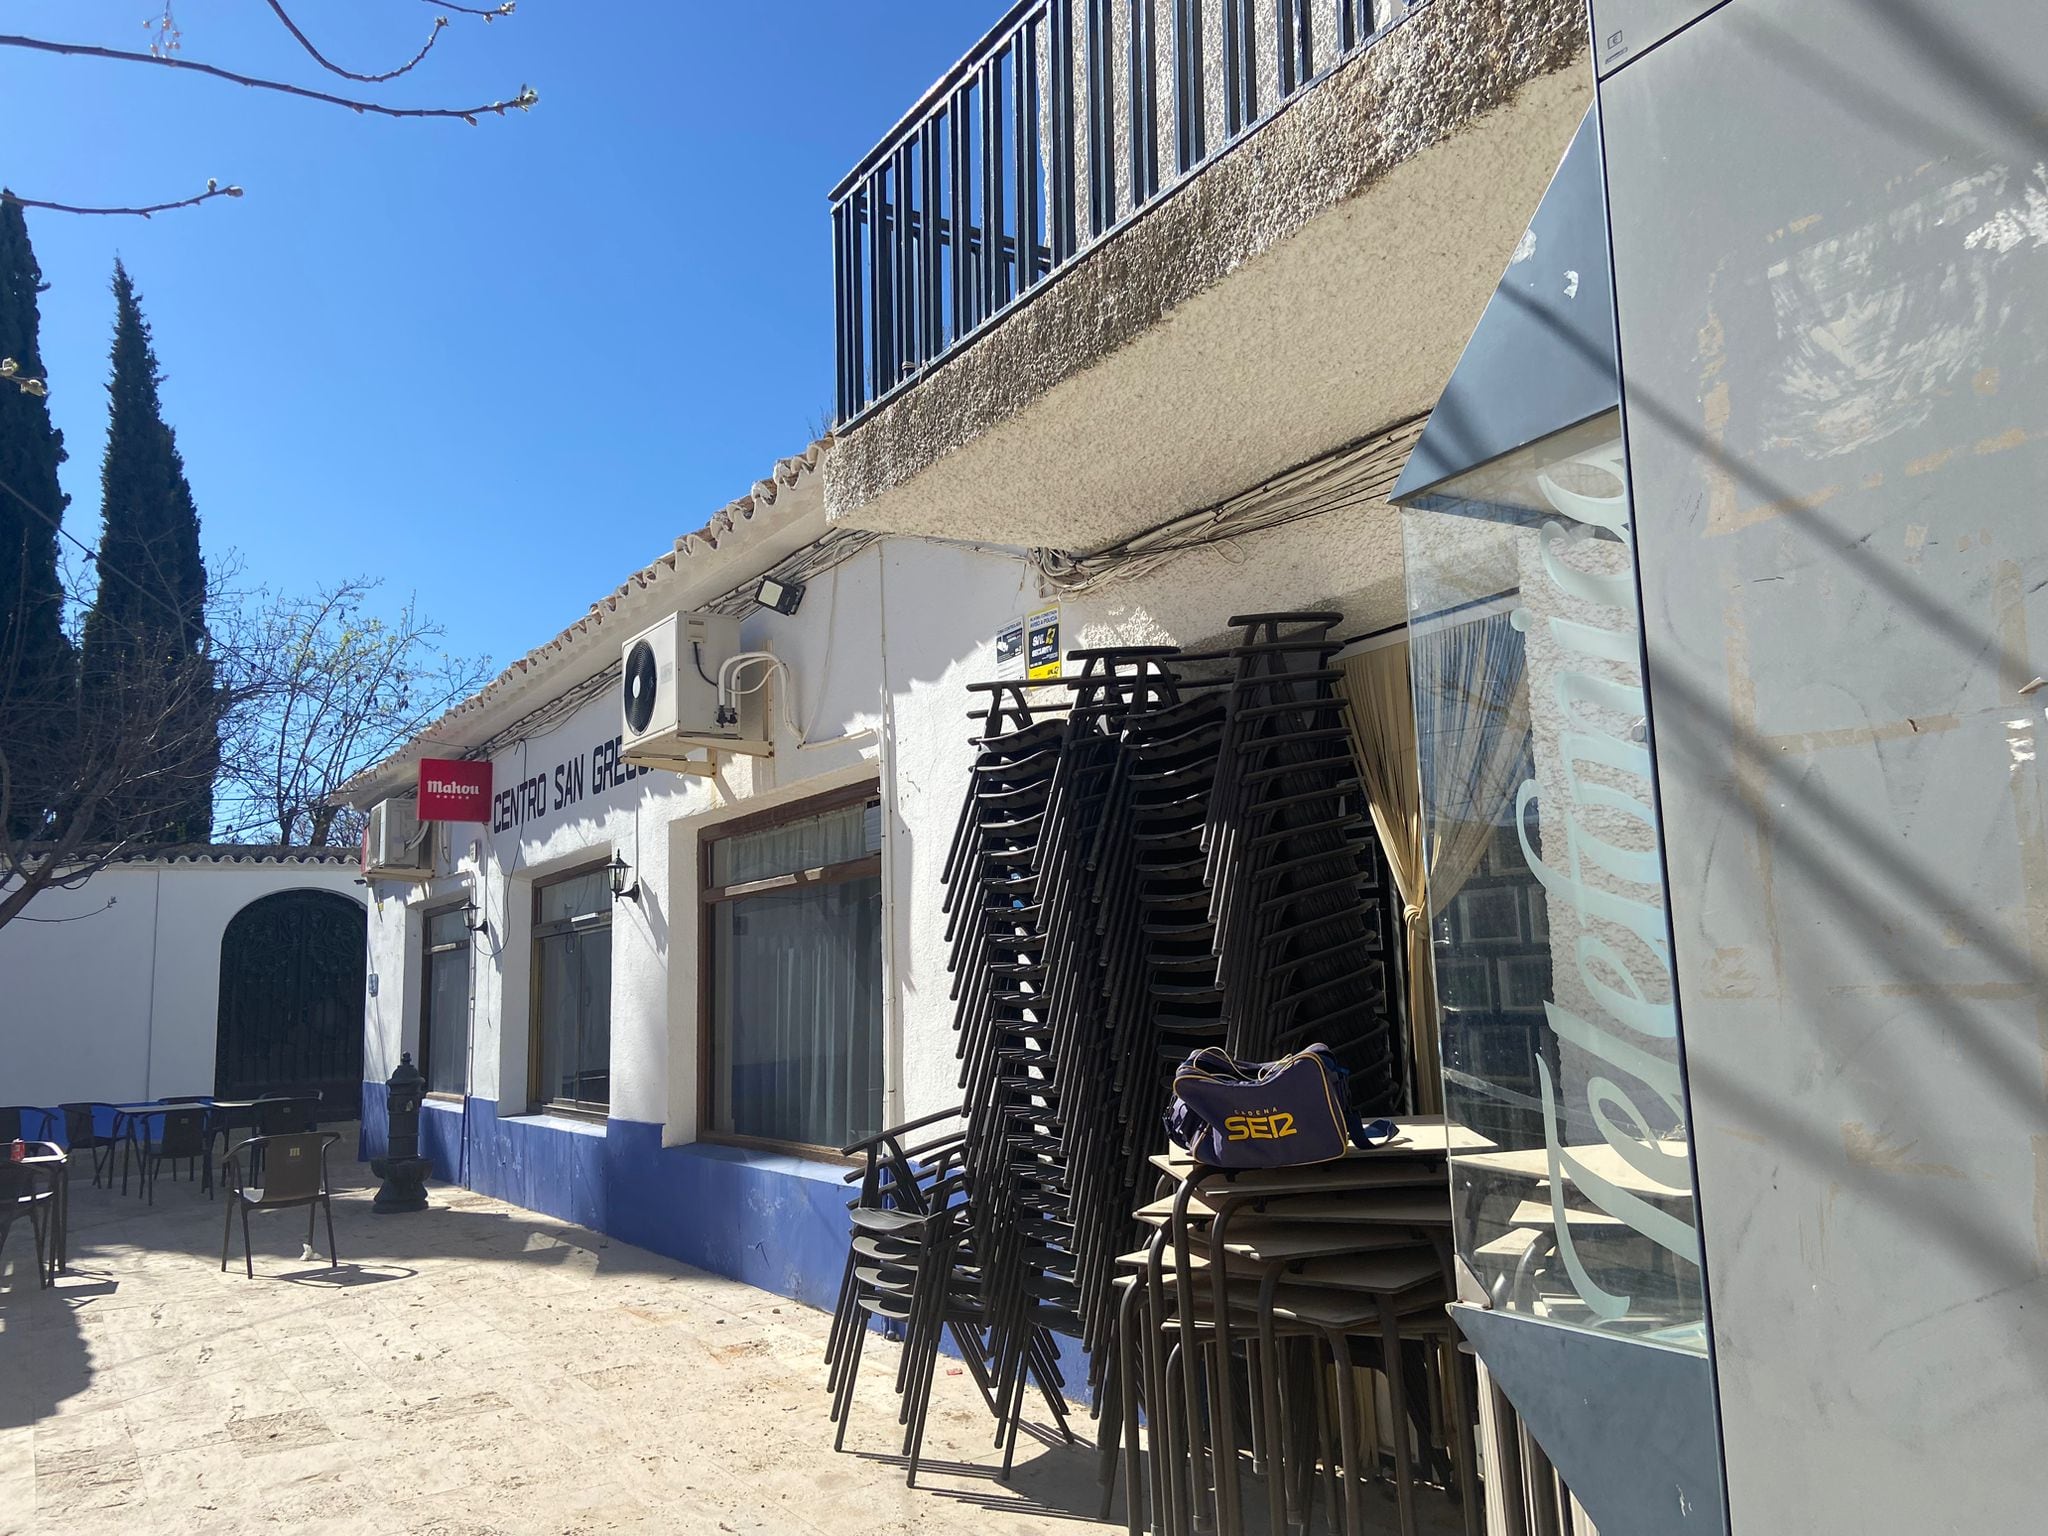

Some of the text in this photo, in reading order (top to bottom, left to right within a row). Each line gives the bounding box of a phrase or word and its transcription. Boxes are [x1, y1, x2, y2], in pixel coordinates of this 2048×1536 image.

[426, 780, 480, 795] Mahou
[493, 773, 547, 834] CENTRO
[554, 753, 585, 811] SAN
